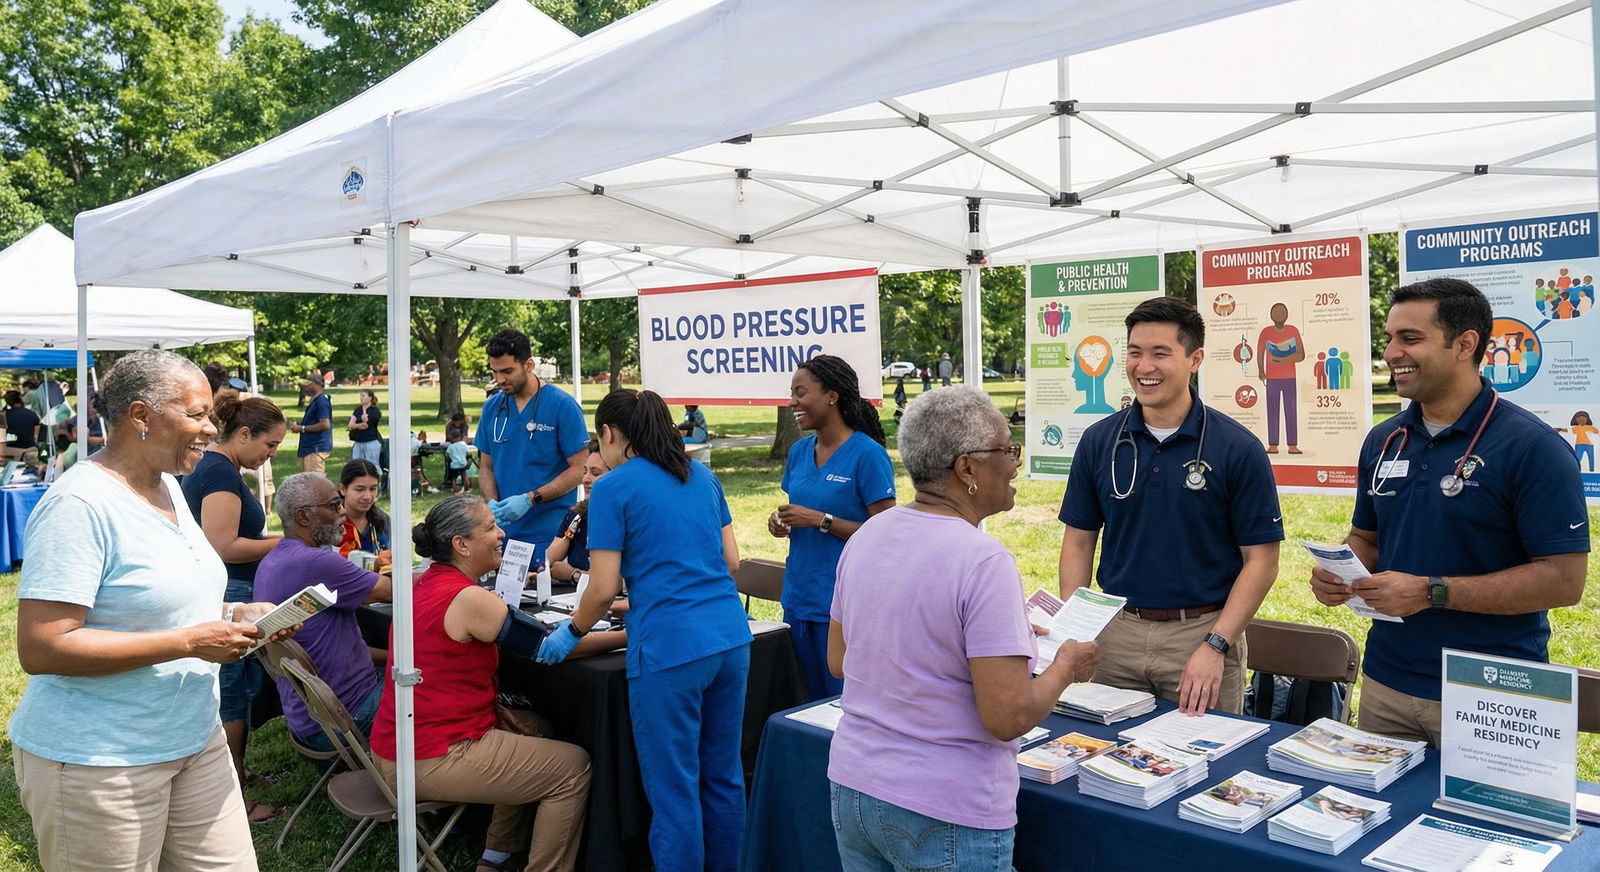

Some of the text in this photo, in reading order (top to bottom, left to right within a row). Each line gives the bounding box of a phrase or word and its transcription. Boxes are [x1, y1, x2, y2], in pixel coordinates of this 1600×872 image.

[1416, 218, 1592, 250] COMMUNITY OUTREACH
[1211, 242, 1351, 268] COMMUNITY OUTREACH
[1459, 241, 1544, 263] PROGRAMS
[1056, 261, 1130, 280] PUBLIC HEALTH
[1246, 261, 1313, 280] PROGRAMS
[1058, 276, 1128, 293] & PREVENTION
[1315, 292, 1341, 307] 20%
[651, 303, 867, 342] BLOOD PRESSURE
[1316, 395, 1342, 409] 33%
[1477, 700, 1538, 721] DISCOVER
[1455, 710, 1562, 740] FAMILY MEDICINE
[1473, 728, 1541, 750] RESIDENCY
